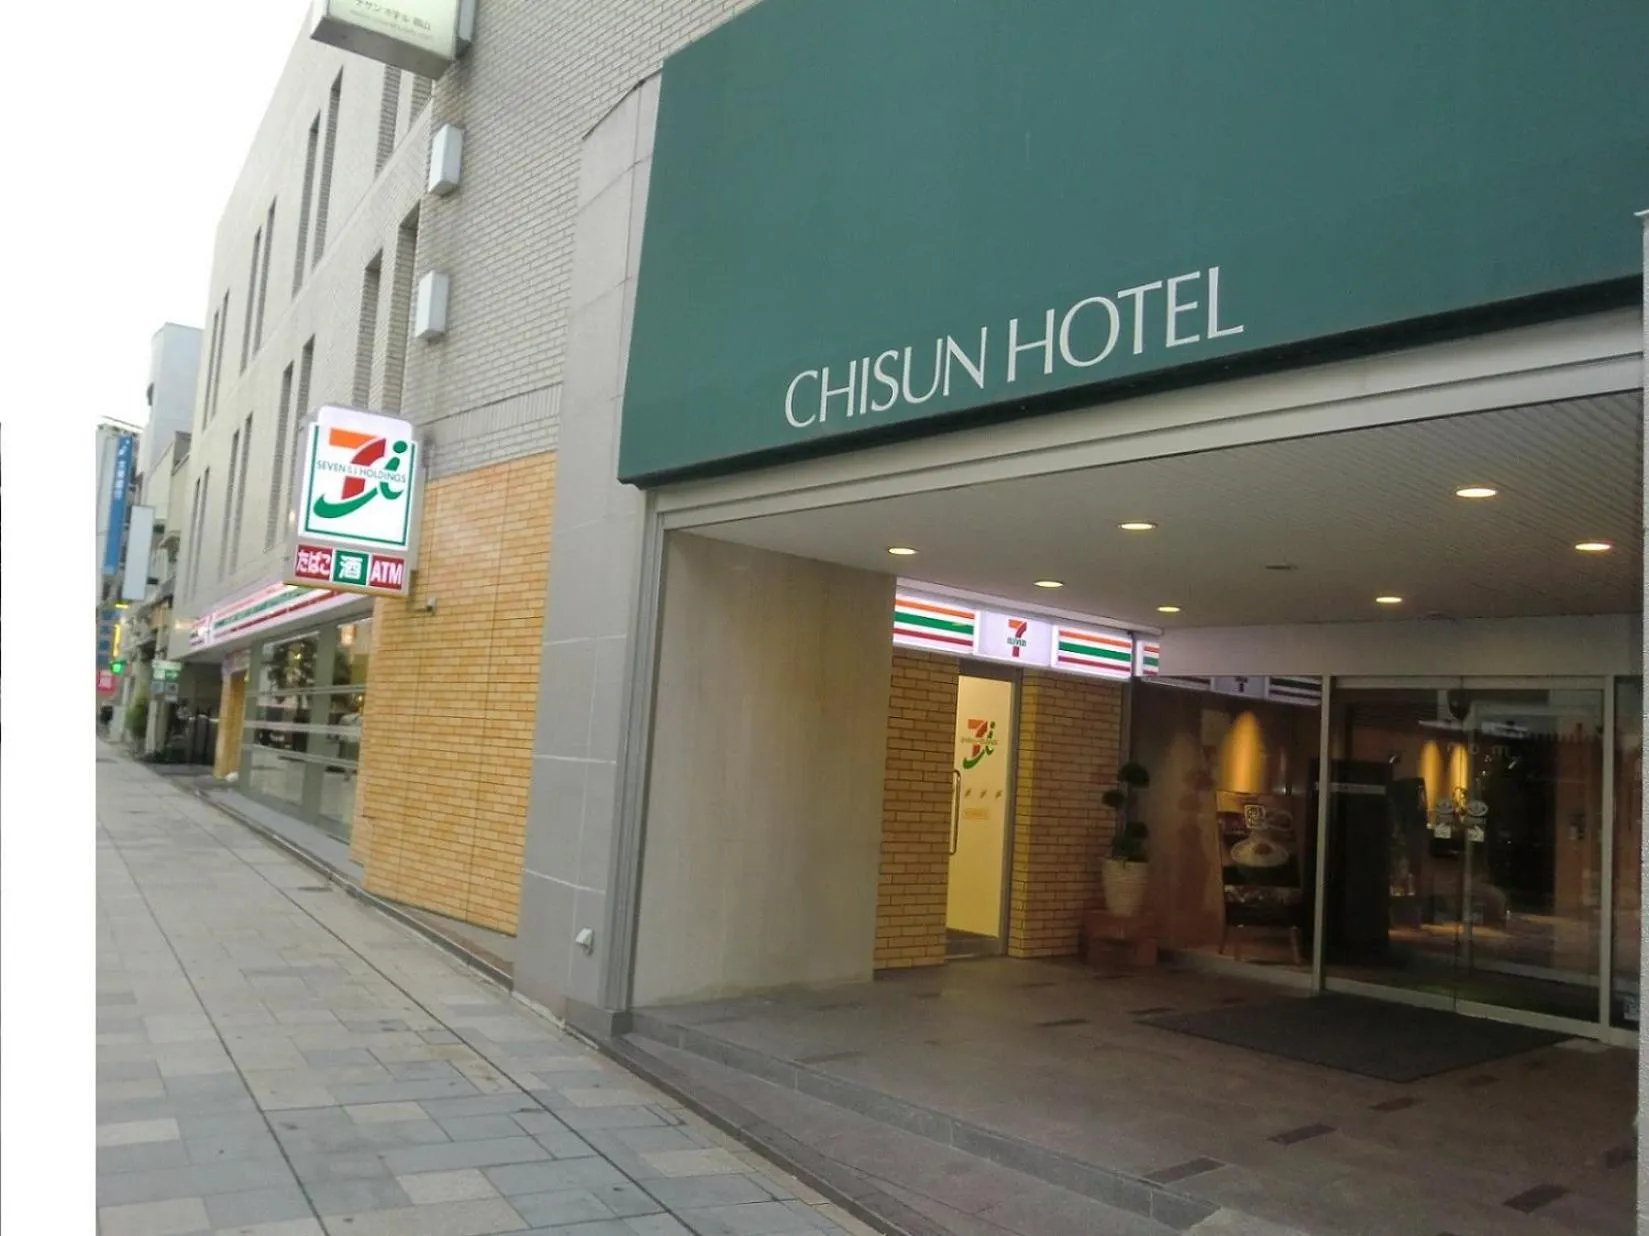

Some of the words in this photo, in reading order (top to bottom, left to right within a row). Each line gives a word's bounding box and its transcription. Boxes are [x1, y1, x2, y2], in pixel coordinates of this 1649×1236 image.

[784, 326, 988, 428] CHISUN
[1006, 265, 1245, 383] HOTEL
[316, 460, 346, 473] SEVEN
[359, 467, 406, 483] HOLDINGS
[296, 549, 330, 575] たばこ
[338, 555, 363, 580] 酒
[371, 561, 403, 585] ATM
